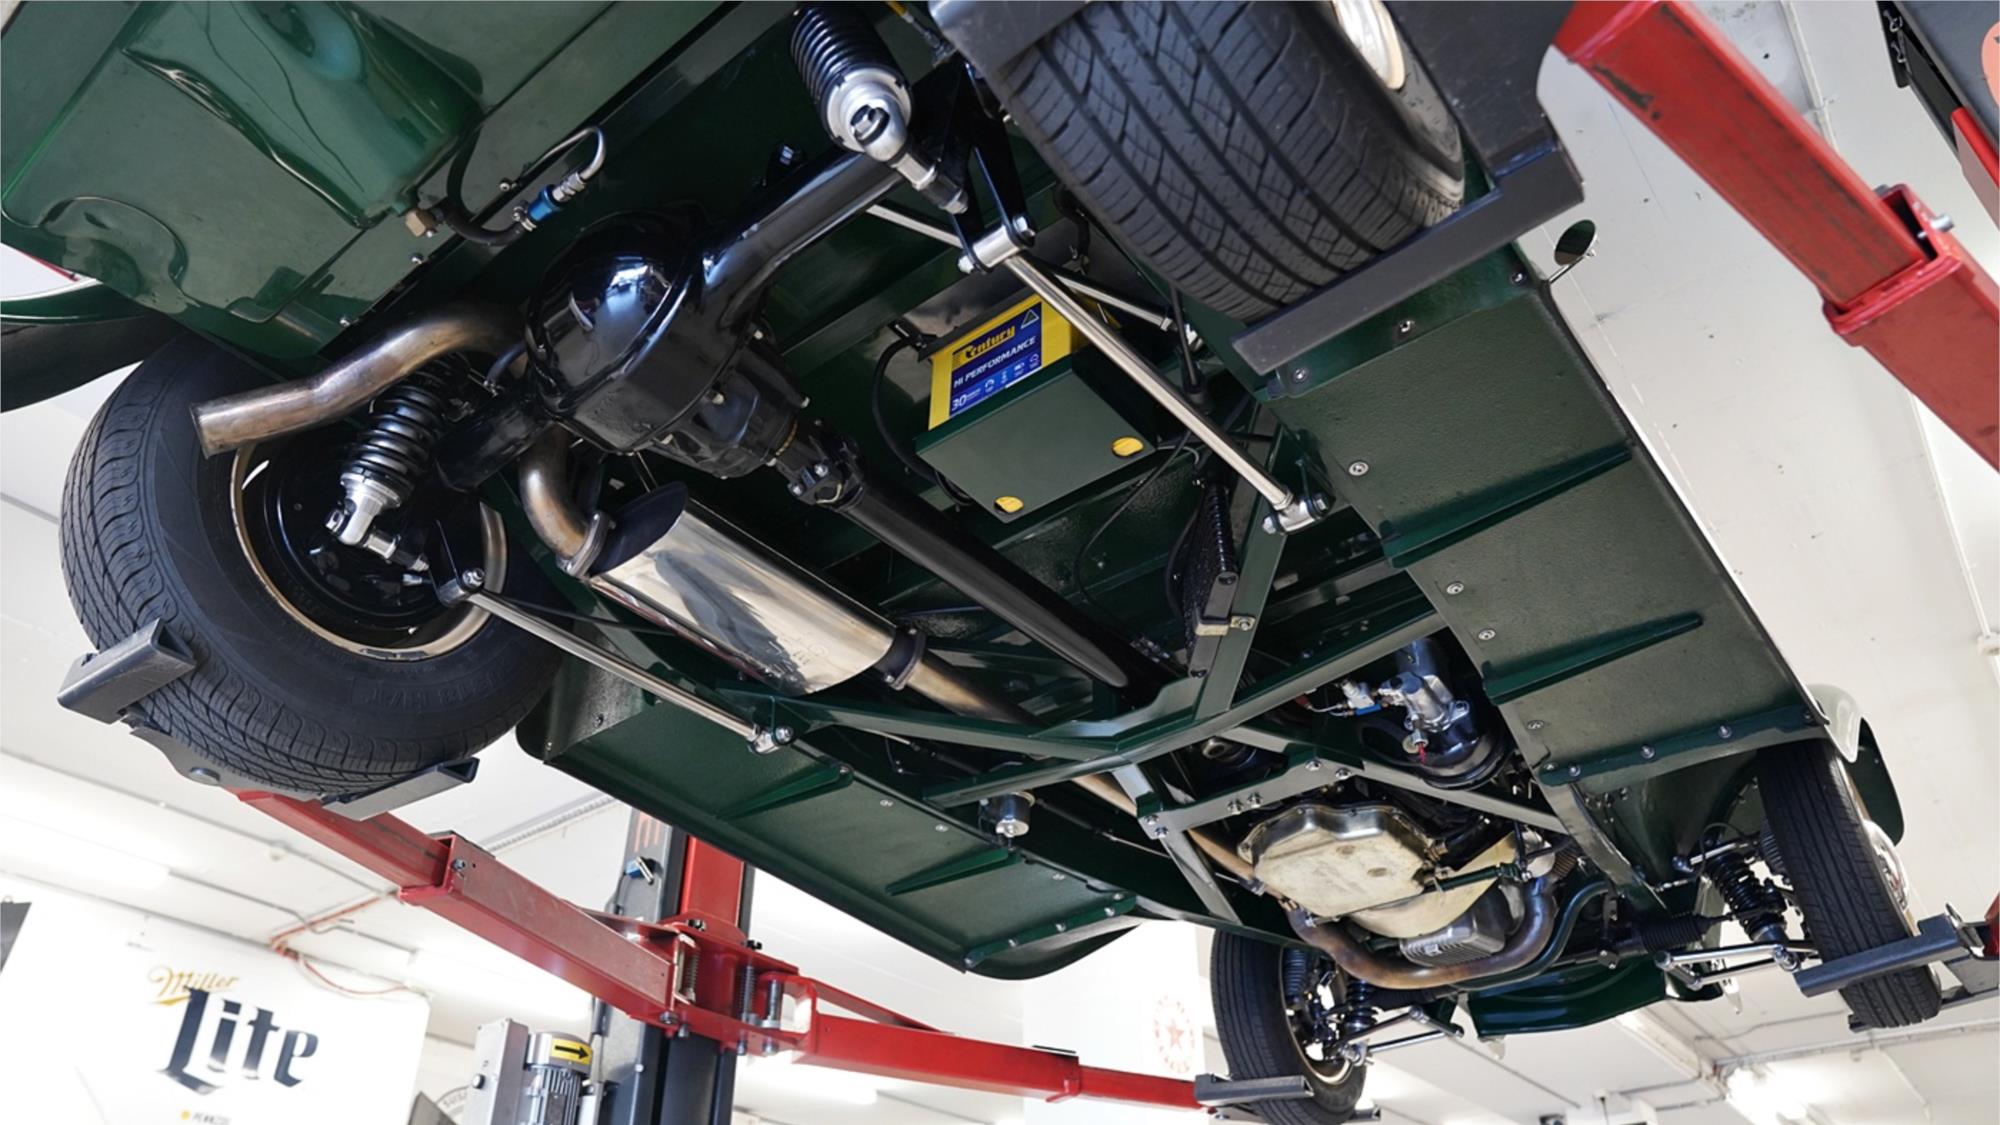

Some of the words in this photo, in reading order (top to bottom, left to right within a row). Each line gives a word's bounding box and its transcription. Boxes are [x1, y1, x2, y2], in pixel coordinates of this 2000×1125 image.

[965, 336, 1036, 383] PERFORMANCE
[951, 394, 967, 411] 30
[157, 985, 319, 1095] Lite
